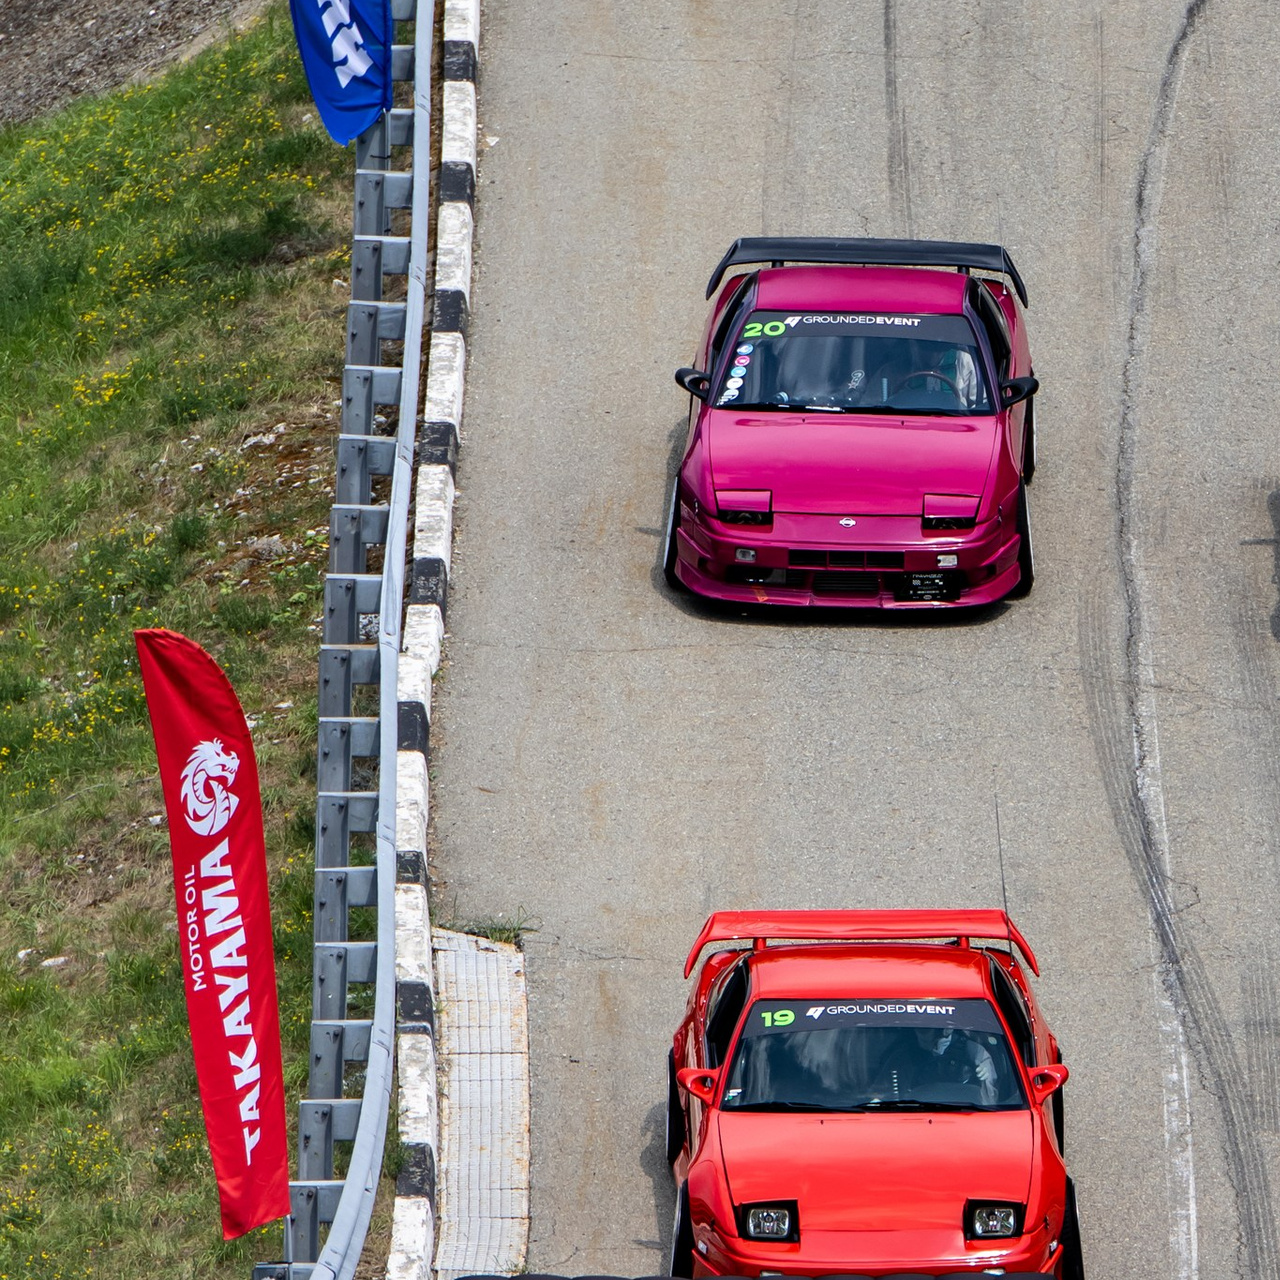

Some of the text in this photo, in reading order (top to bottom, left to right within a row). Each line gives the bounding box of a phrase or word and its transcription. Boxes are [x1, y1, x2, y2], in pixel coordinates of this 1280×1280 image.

[743, 321, 786, 338] 20
[184, 865, 207, 991] MOTOR OIL
[200, 837, 262, 1167] TAKAYAMA
[761, 1009, 796, 1028] 19
